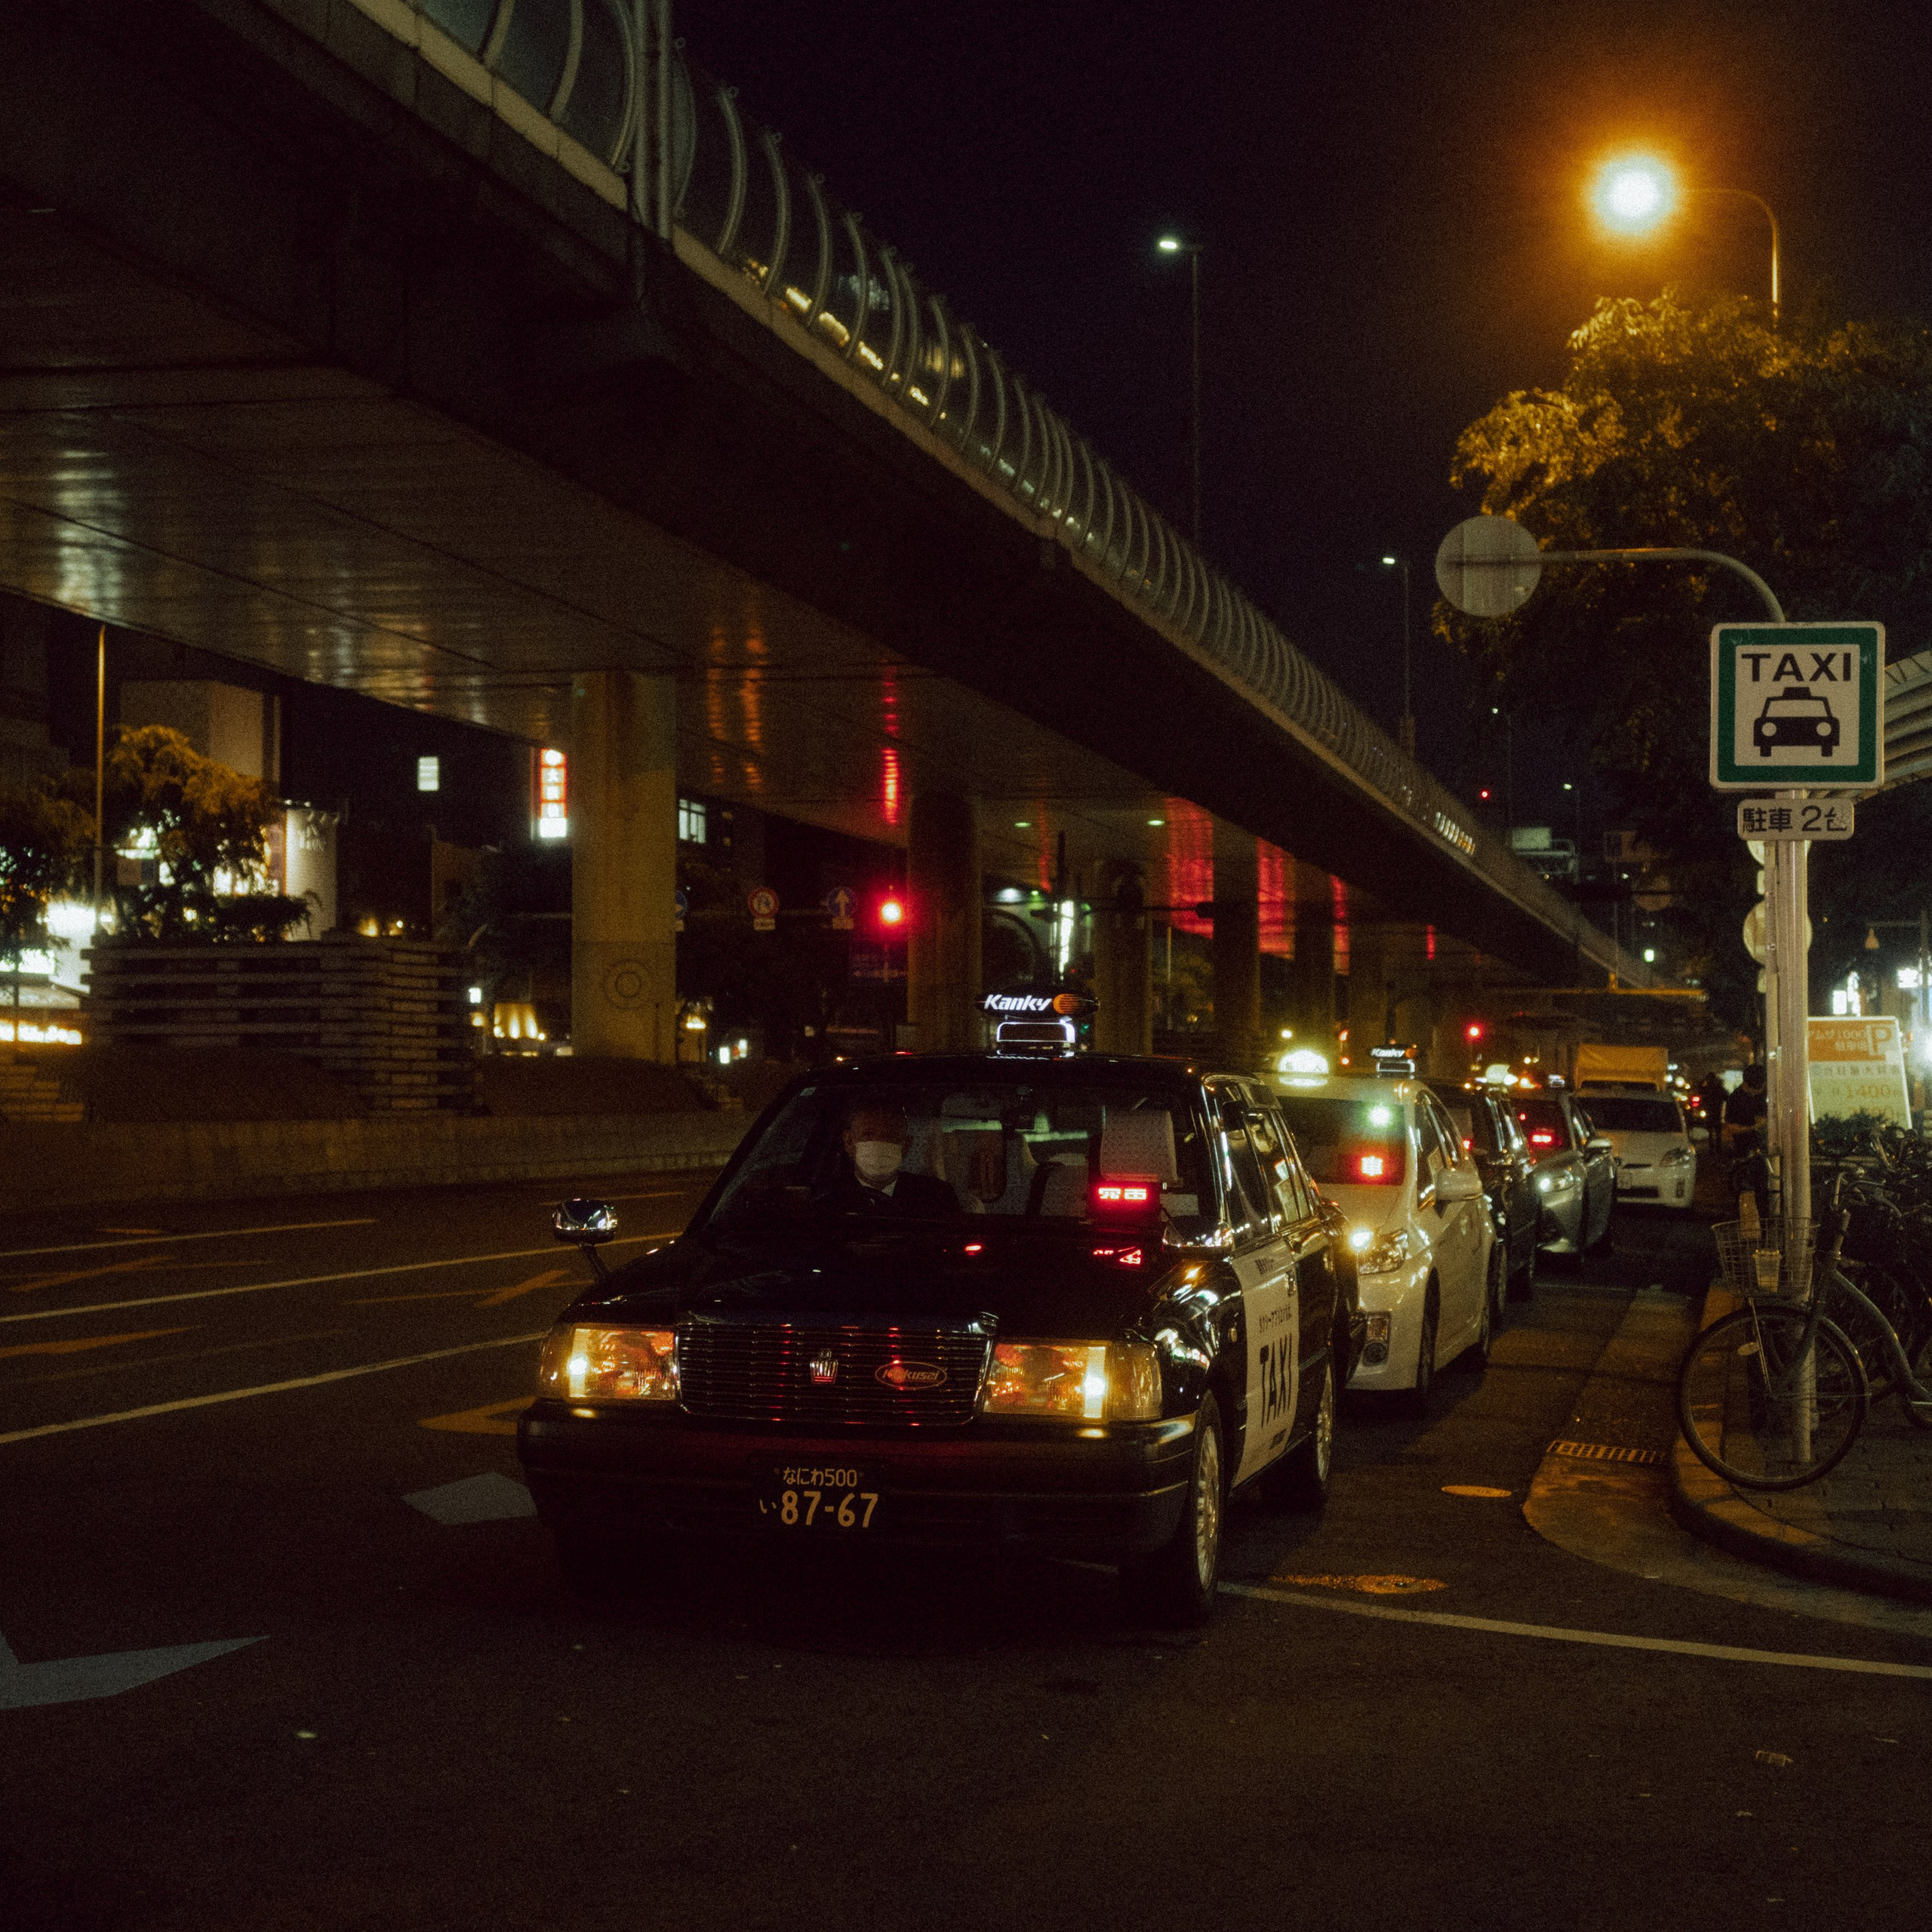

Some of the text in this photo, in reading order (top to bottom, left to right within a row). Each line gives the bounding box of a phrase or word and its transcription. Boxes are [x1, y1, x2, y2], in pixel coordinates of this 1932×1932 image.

[1742, 653, 1851, 681] TAXI
[1743, 808, 1792, 833] 駐車
[984, 994, 1052, 1011] Kanky
[1371, 1048, 1405, 1057] Kanky
[882, 1369, 939, 1381] Kkusai
[1260, 1332, 1293, 1428] TAXI
[759, 1491, 878, 1528] い 87-67
